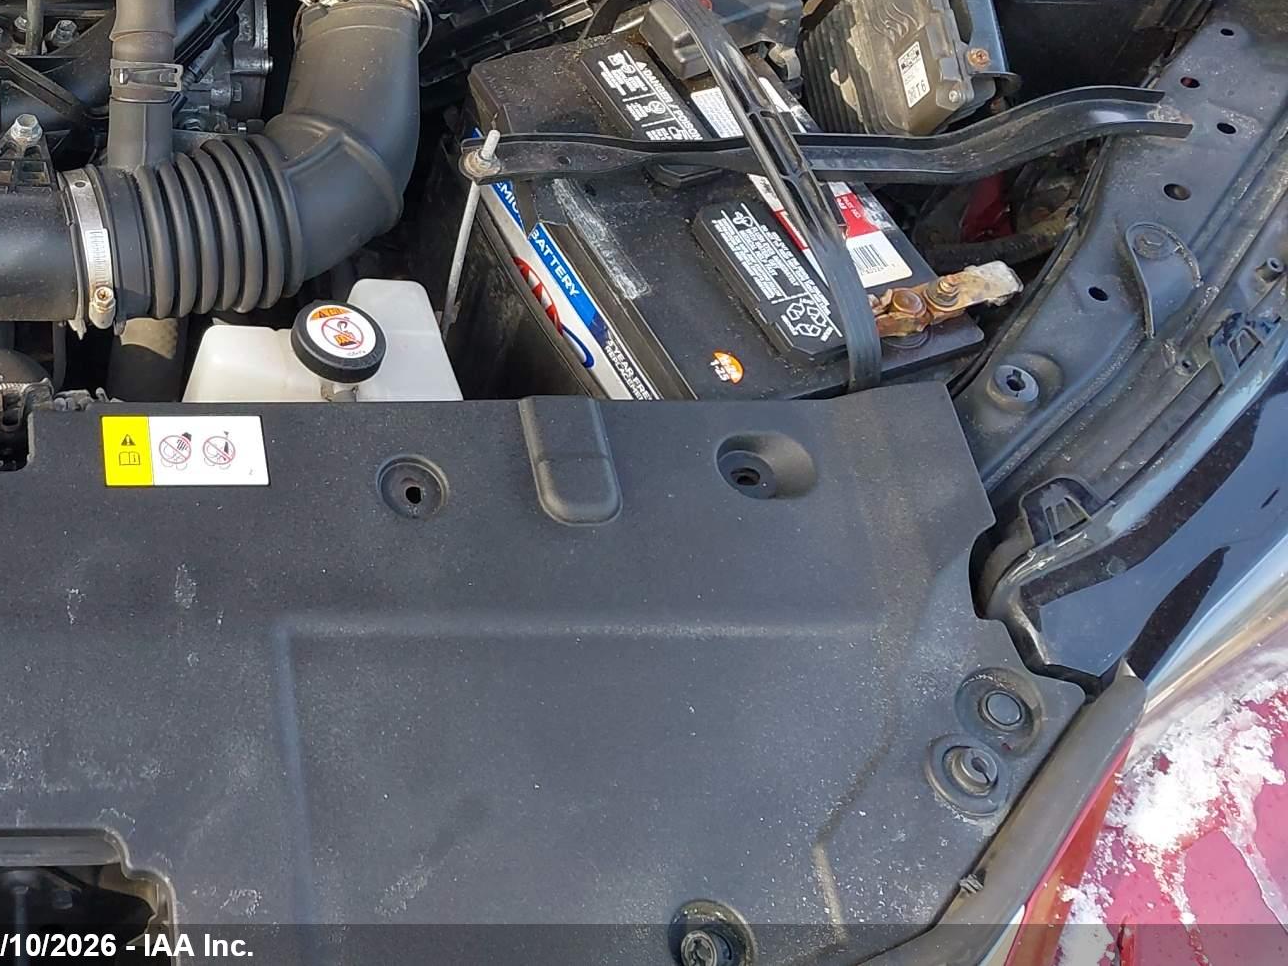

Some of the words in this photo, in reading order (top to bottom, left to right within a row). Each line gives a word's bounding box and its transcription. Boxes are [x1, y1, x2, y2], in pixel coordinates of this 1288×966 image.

[644, 67, 674, 103] DANGER
[673, 110, 703, 140] POISON
[530, 229, 580, 297] BATTERY
[613, 343, 634, 377] YEAR
[632, 376, 652, 400] FRE
